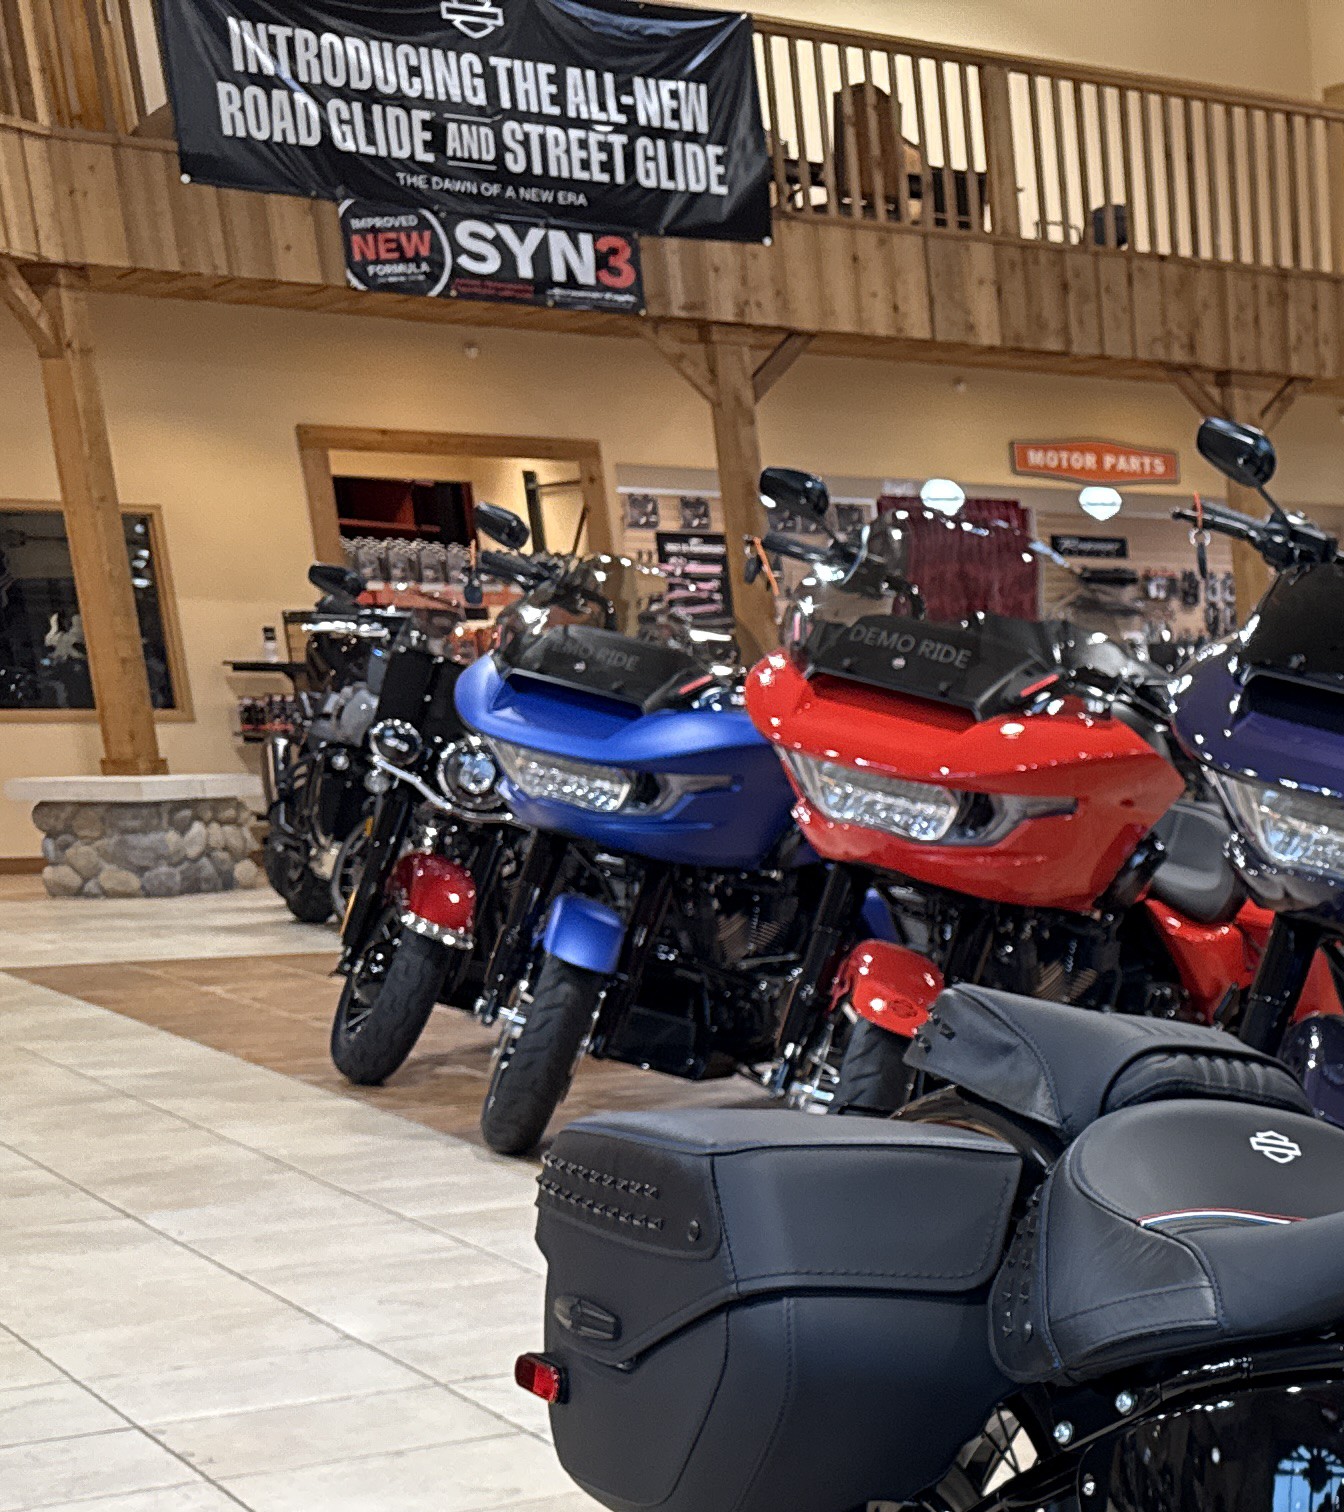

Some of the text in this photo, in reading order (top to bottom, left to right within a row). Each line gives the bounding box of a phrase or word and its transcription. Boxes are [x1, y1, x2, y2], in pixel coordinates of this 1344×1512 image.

[227, 16, 709, 134] INTRODUCING THE ALL-NEW
[217, 81, 728, 195] ROAD GLIDE AND STREET GLIDE
[395, 171, 589, 207] THE DAWN OF A NEW ERA
[351, 230, 431, 262] NEW
[454, 219, 637, 290] SYN3
[367, 261, 430, 277] FORMULA
[1026, 448, 1166, 475] MOTOR PARTS
[849, 623, 973, 669] DEMO RIDE
